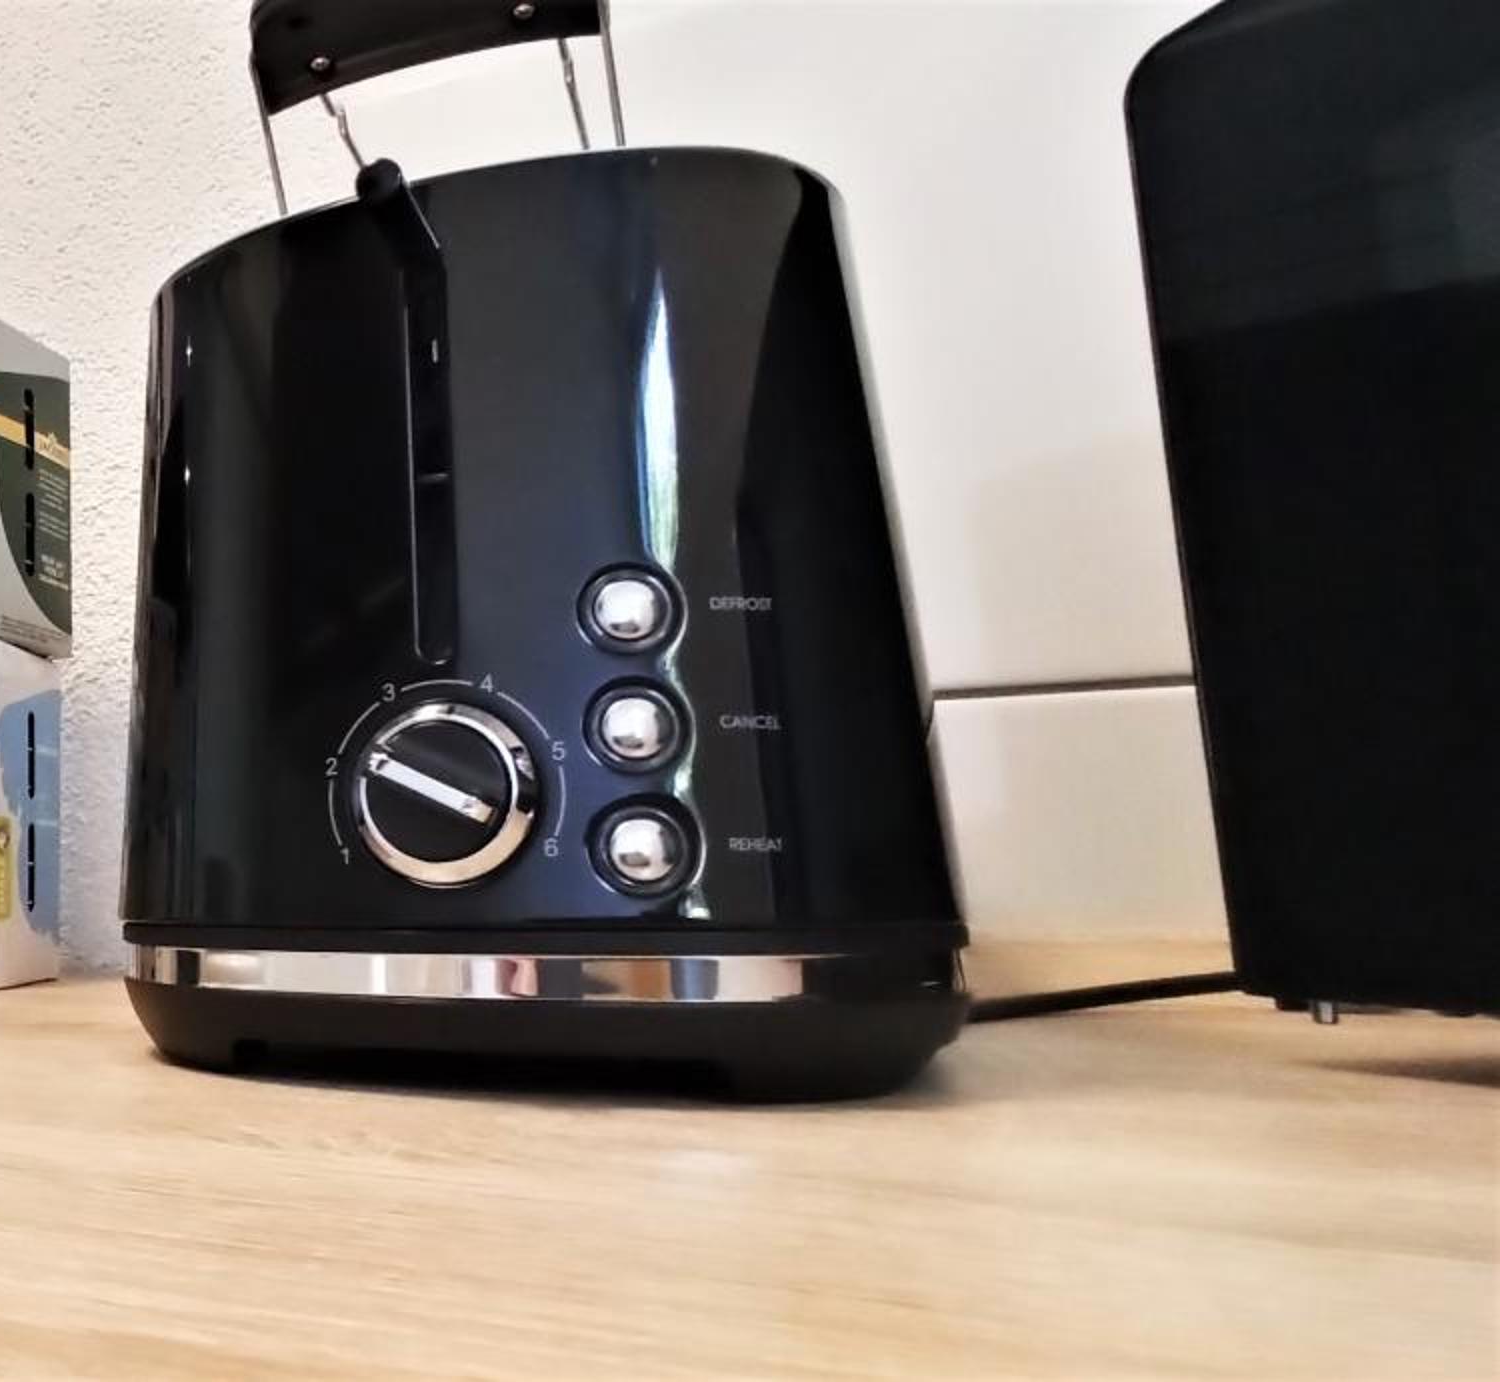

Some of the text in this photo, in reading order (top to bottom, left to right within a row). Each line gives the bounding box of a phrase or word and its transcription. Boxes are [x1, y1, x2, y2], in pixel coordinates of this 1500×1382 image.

[709, 596, 772, 611] DEFROST
[383, 684, 396, 701] 3
[480, 675, 494, 693] 4
[719, 715, 780, 730] CANCEL
[552, 742, 565, 760] 5
[325, 757, 338, 775] 2
[544, 839, 559, 857] 6
[728, 837, 782, 852] REHEAT
[341, 847, 350, 864] 1
